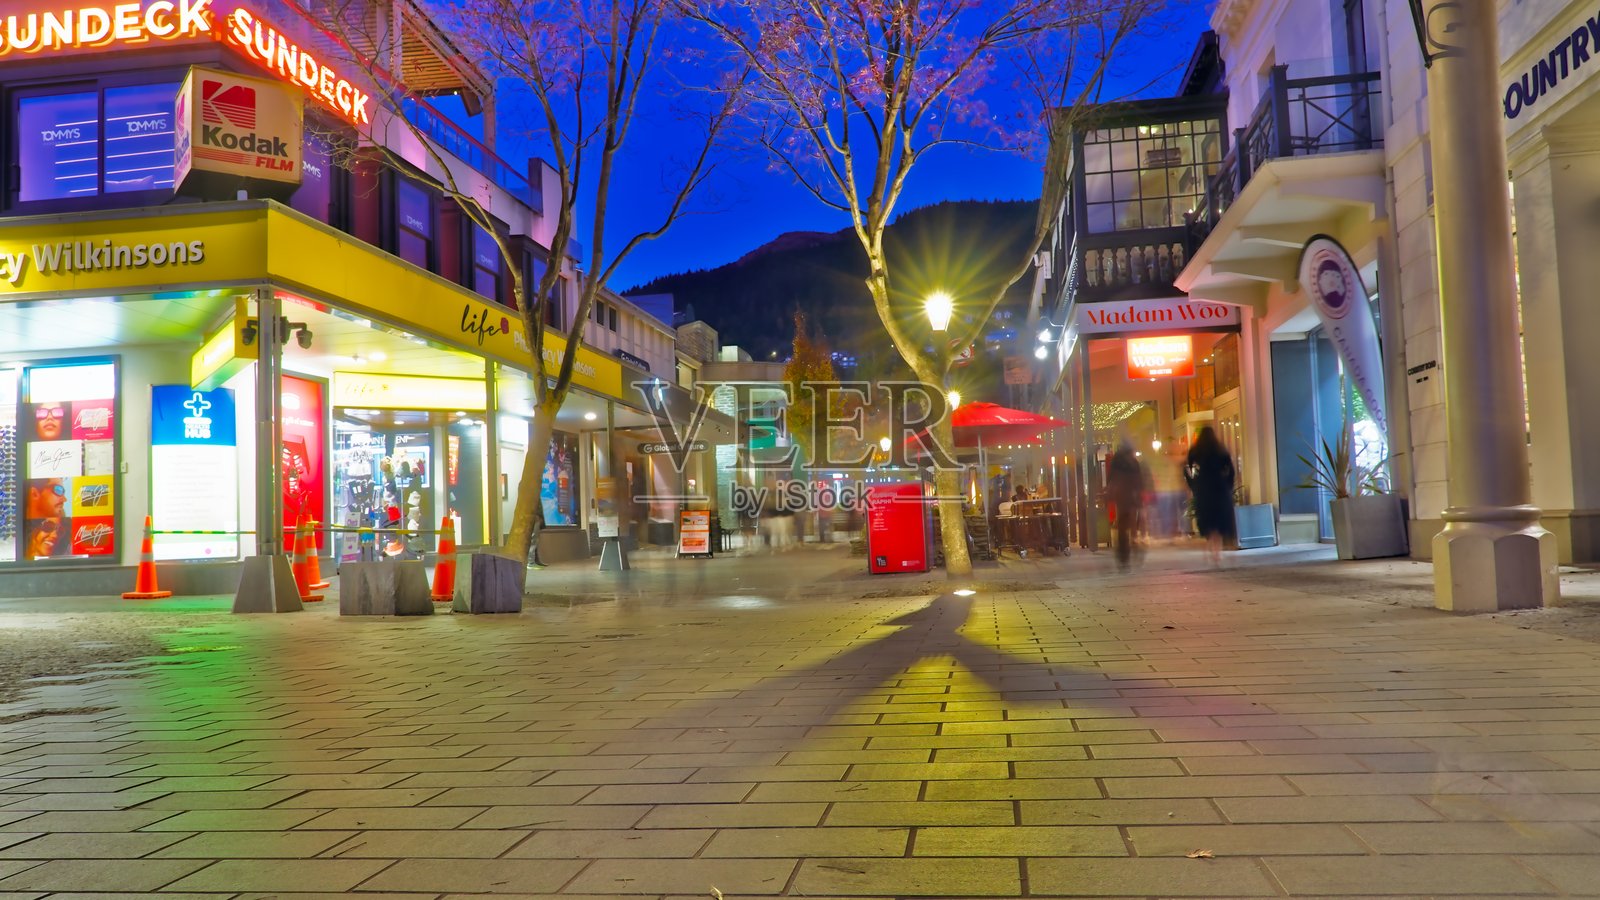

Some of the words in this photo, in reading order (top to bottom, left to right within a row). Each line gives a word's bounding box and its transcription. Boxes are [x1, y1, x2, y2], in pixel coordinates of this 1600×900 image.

[229, 8, 369, 124] SUNDECK
[1503, 9, 1600, 119] OUNTRY
[202, 124, 288, 158] Kodak
[255, 156, 294, 172] FILM
[33, 239, 205, 273] Wilkinsons
[461, 304, 502, 346] life
[1087, 305, 1174, 326] Madam
[1177, 303, 1229, 321] Woo
[1132, 356, 1166, 368] Woo
